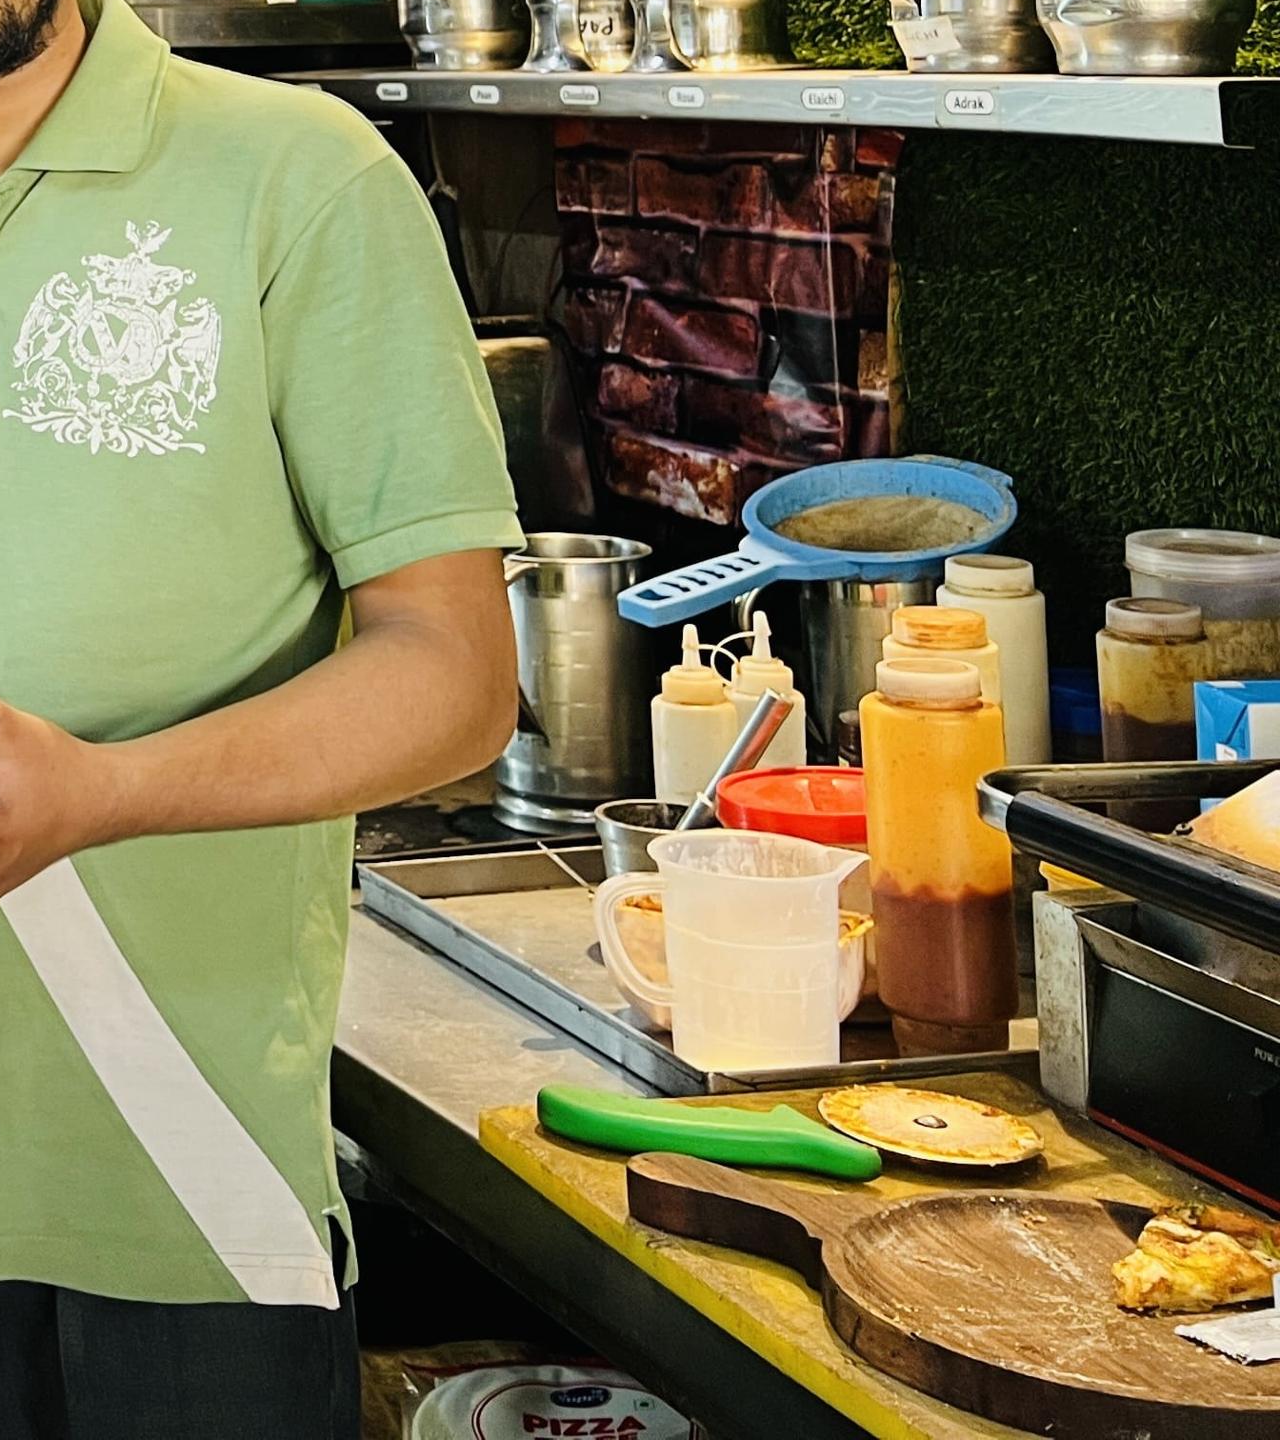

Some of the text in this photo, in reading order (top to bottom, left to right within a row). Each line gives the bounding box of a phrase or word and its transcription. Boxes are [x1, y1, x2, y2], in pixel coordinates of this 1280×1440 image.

[808, 93, 838, 106] Elaichi
[953, 95, 985, 110] Adrak
[522, 1412, 647, 1437] PIZZA
